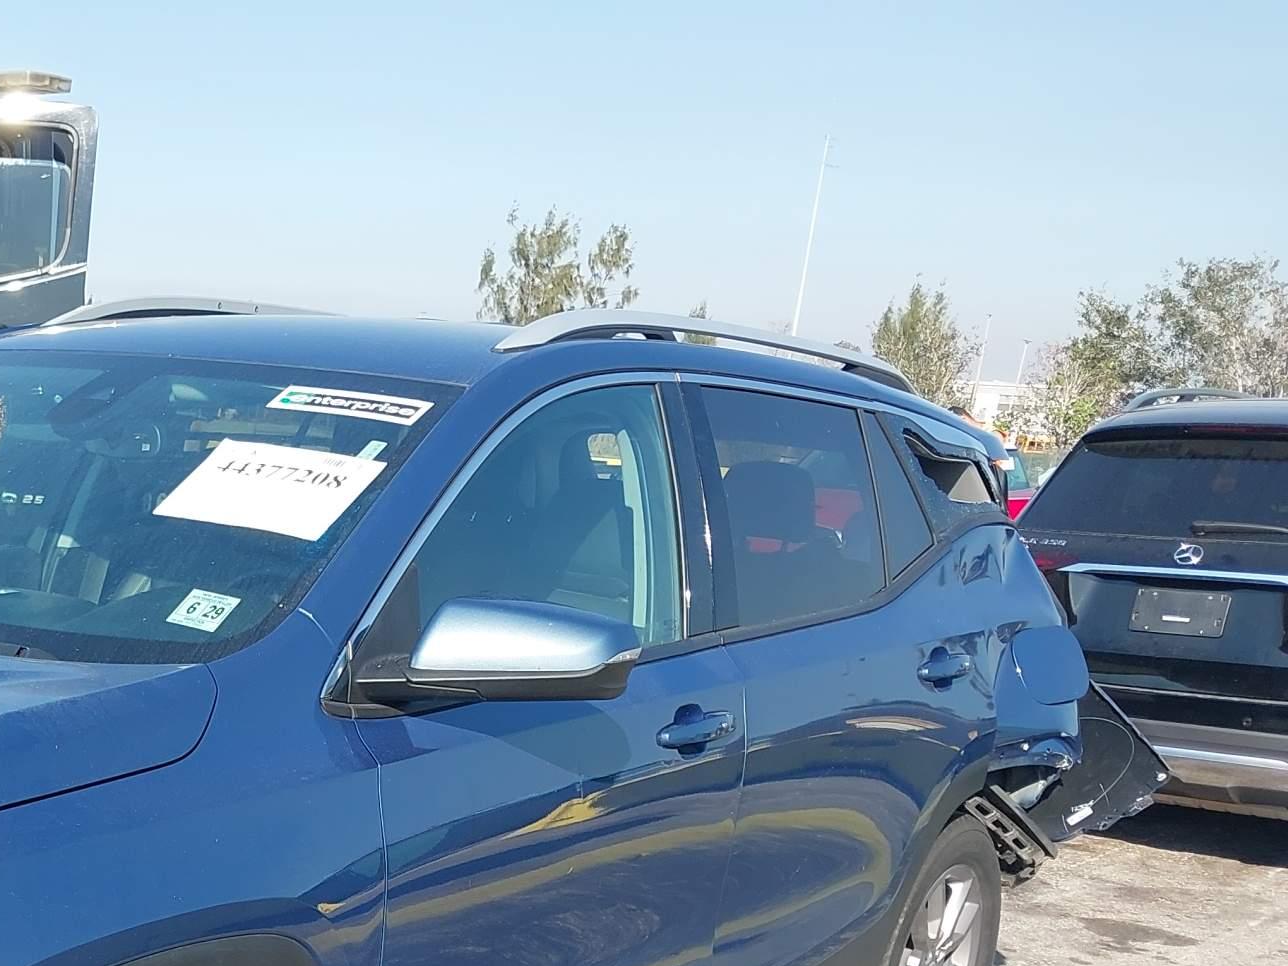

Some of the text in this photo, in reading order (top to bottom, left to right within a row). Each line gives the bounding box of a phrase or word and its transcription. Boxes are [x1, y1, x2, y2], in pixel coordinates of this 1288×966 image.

[287, 392, 418, 418] enterprise
[217, 459, 348, 489] 44377208
[186, 601, 225, 620] 6 29
